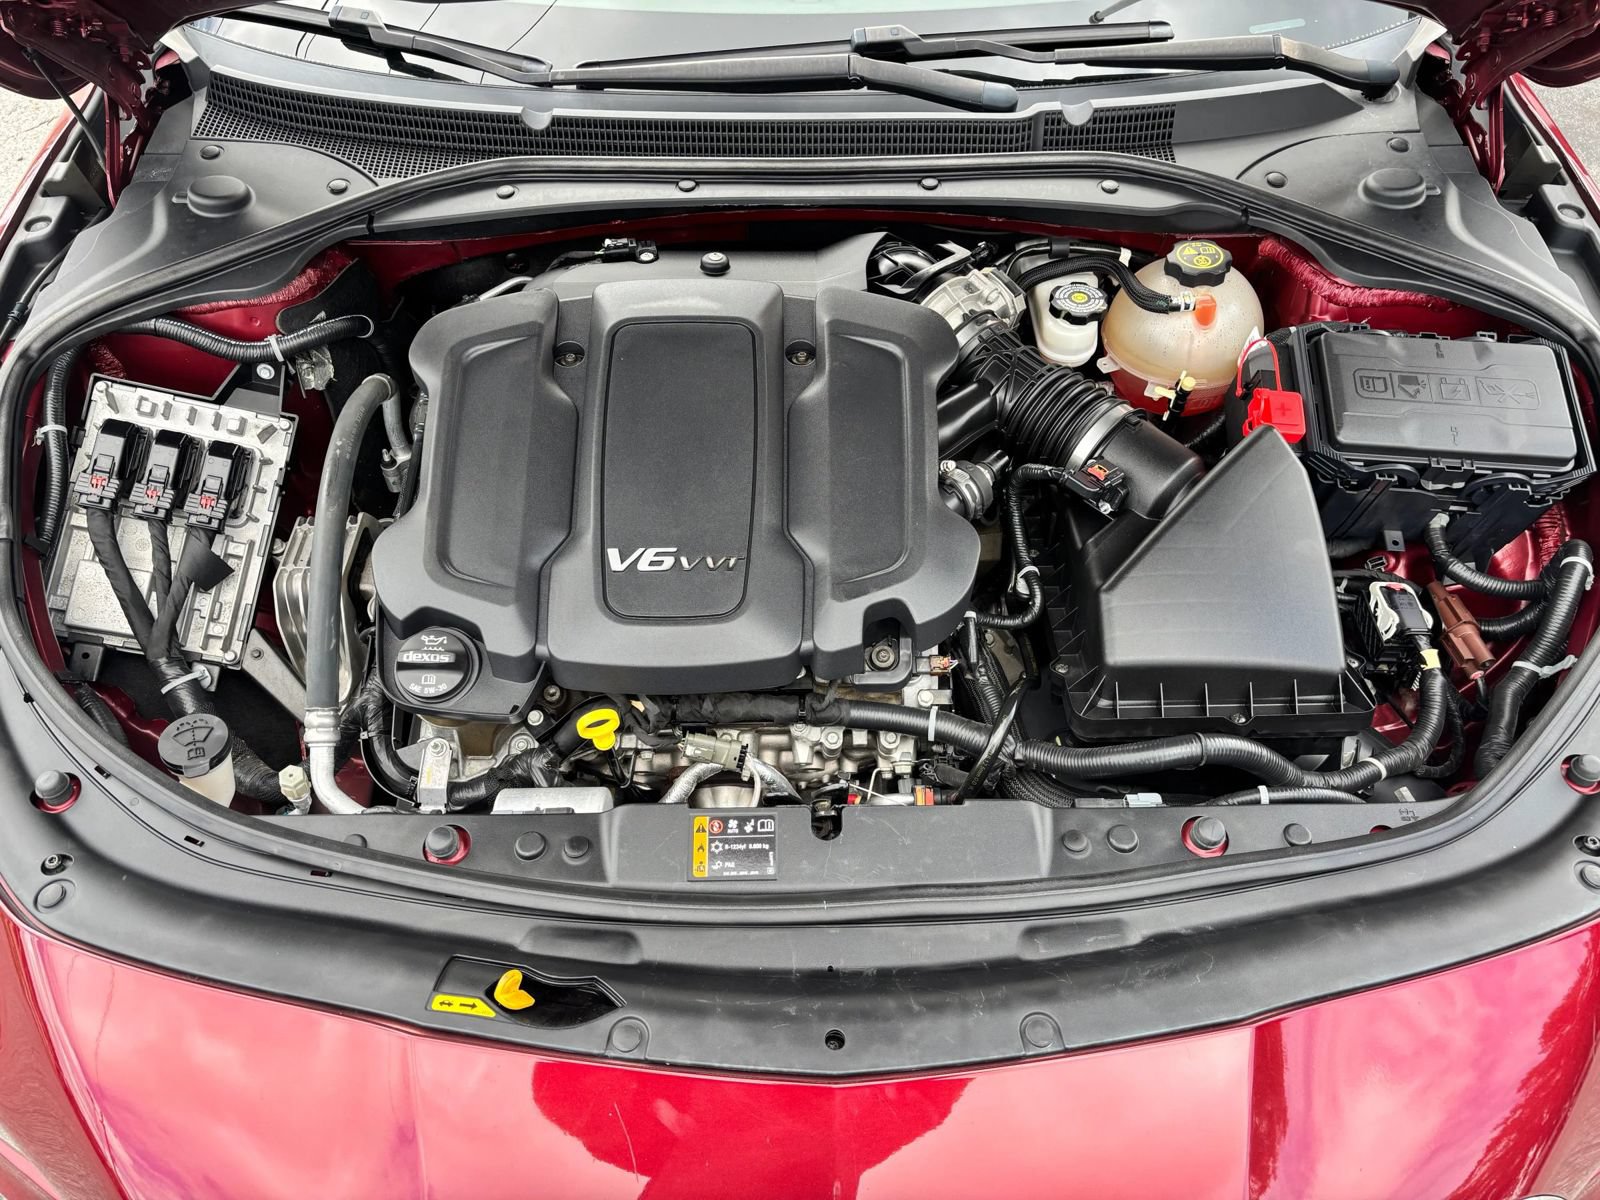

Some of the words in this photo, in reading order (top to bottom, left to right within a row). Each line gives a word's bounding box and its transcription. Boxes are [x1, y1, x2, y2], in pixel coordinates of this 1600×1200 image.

[607, 547, 678, 571] V6
[403, 651, 449, 662] dexos
[409, 683, 422, 693] SAE
[423, 683, 448, 694] 5W-30
